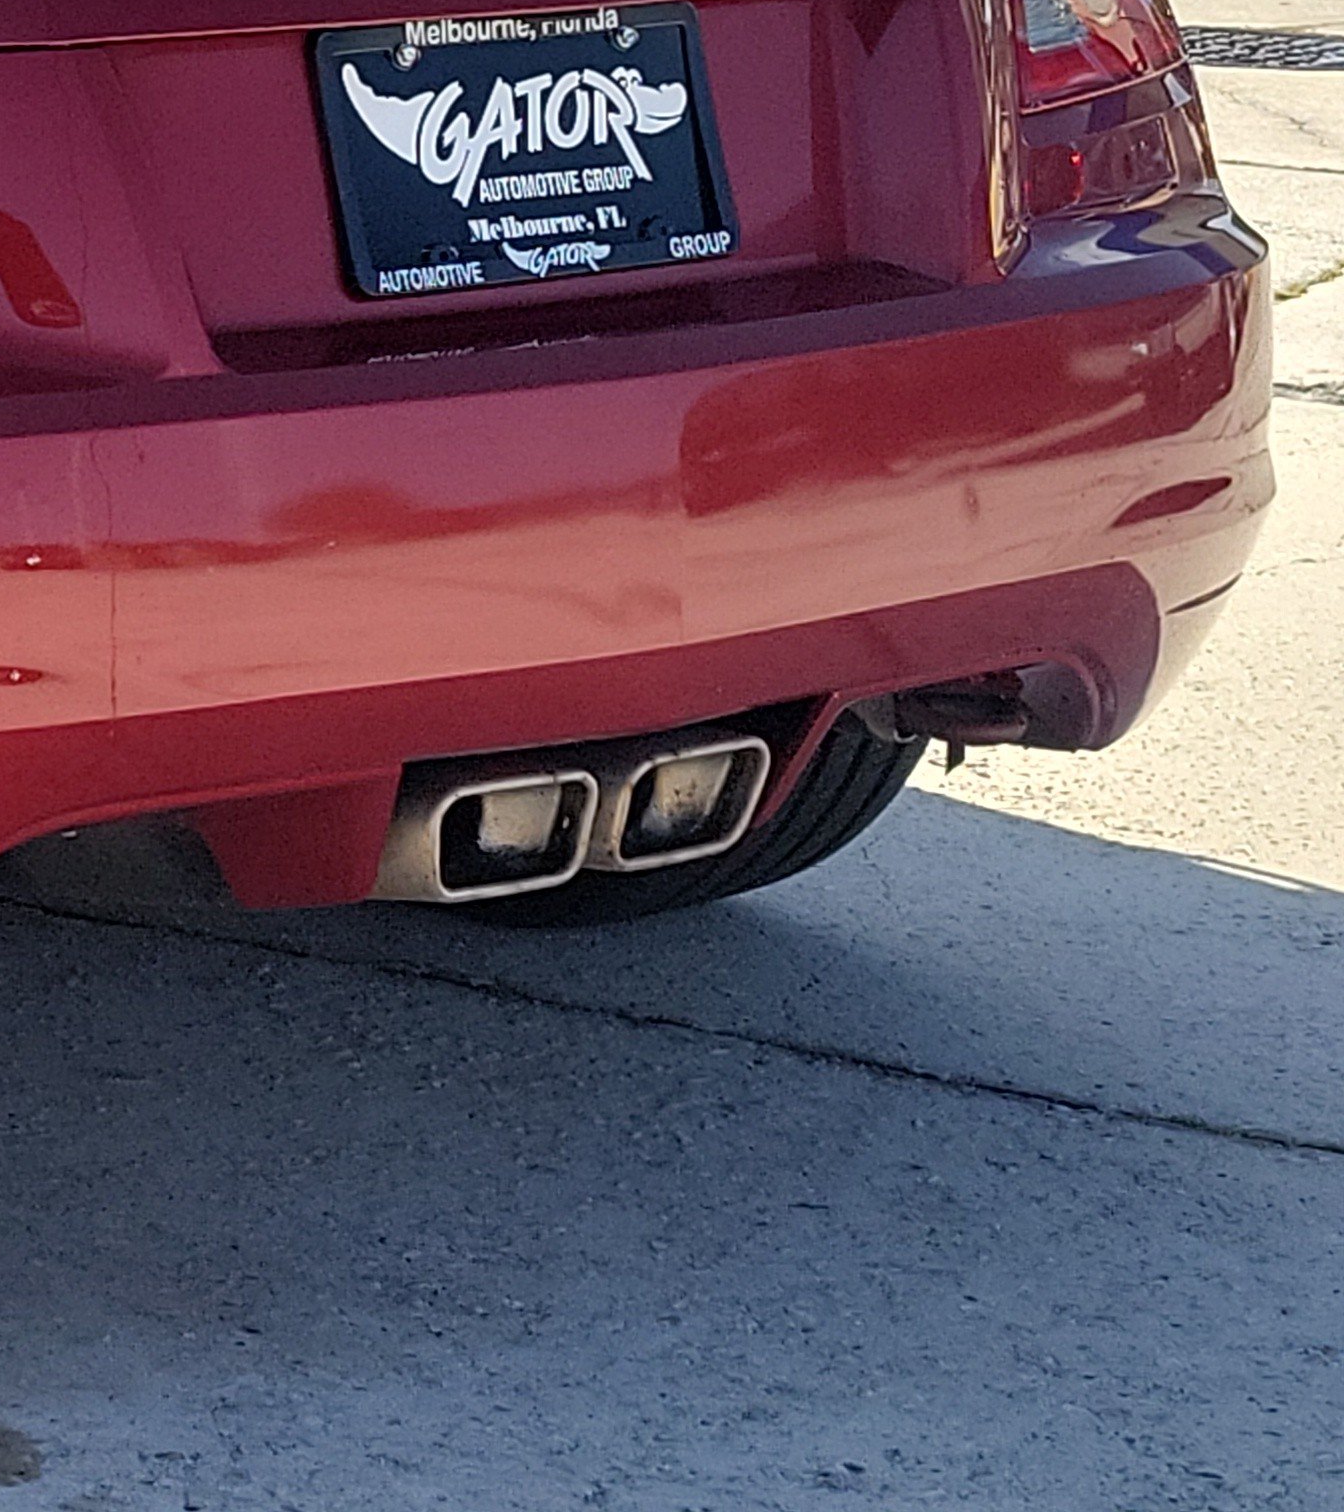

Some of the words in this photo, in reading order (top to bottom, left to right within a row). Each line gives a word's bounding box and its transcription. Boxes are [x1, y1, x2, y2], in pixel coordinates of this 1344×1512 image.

[404, 18, 536, 47] Melbourne,
[420, 69, 653, 207] GATOR
[479, 171, 581, 203] AUTOMOTIVE
[583, 166, 634, 192] GROUP
[467, 208, 595, 243] Melbourne,
[598, 205, 627, 231] FL
[379, 261, 485, 293] AUTOMOTIVE
[530, 241, 600, 278] GATOR
[669, 231, 731, 258] GROUP
